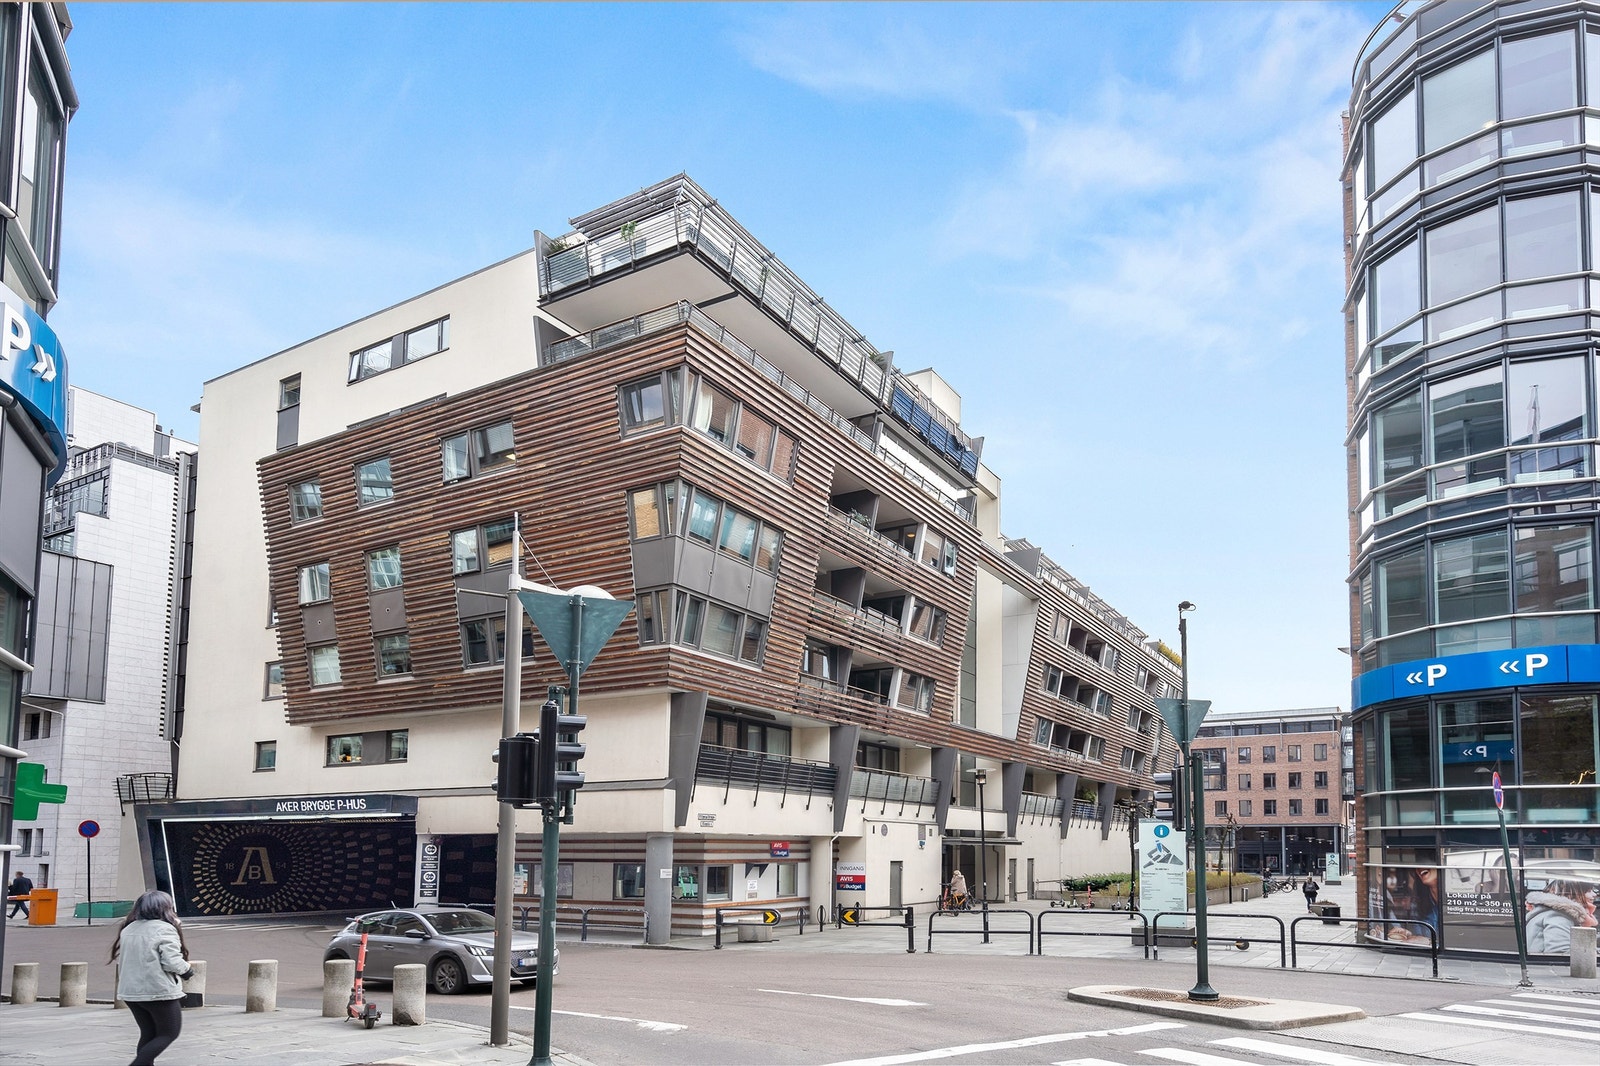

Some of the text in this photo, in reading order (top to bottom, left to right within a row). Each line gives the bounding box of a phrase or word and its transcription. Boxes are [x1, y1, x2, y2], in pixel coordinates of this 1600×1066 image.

[0, 302, 31, 360] P
[1427, 664, 1447, 686] P
[1525, 653, 1549, 677] P
[276, 799, 367, 812] AKER BRYGGE P-HUS
